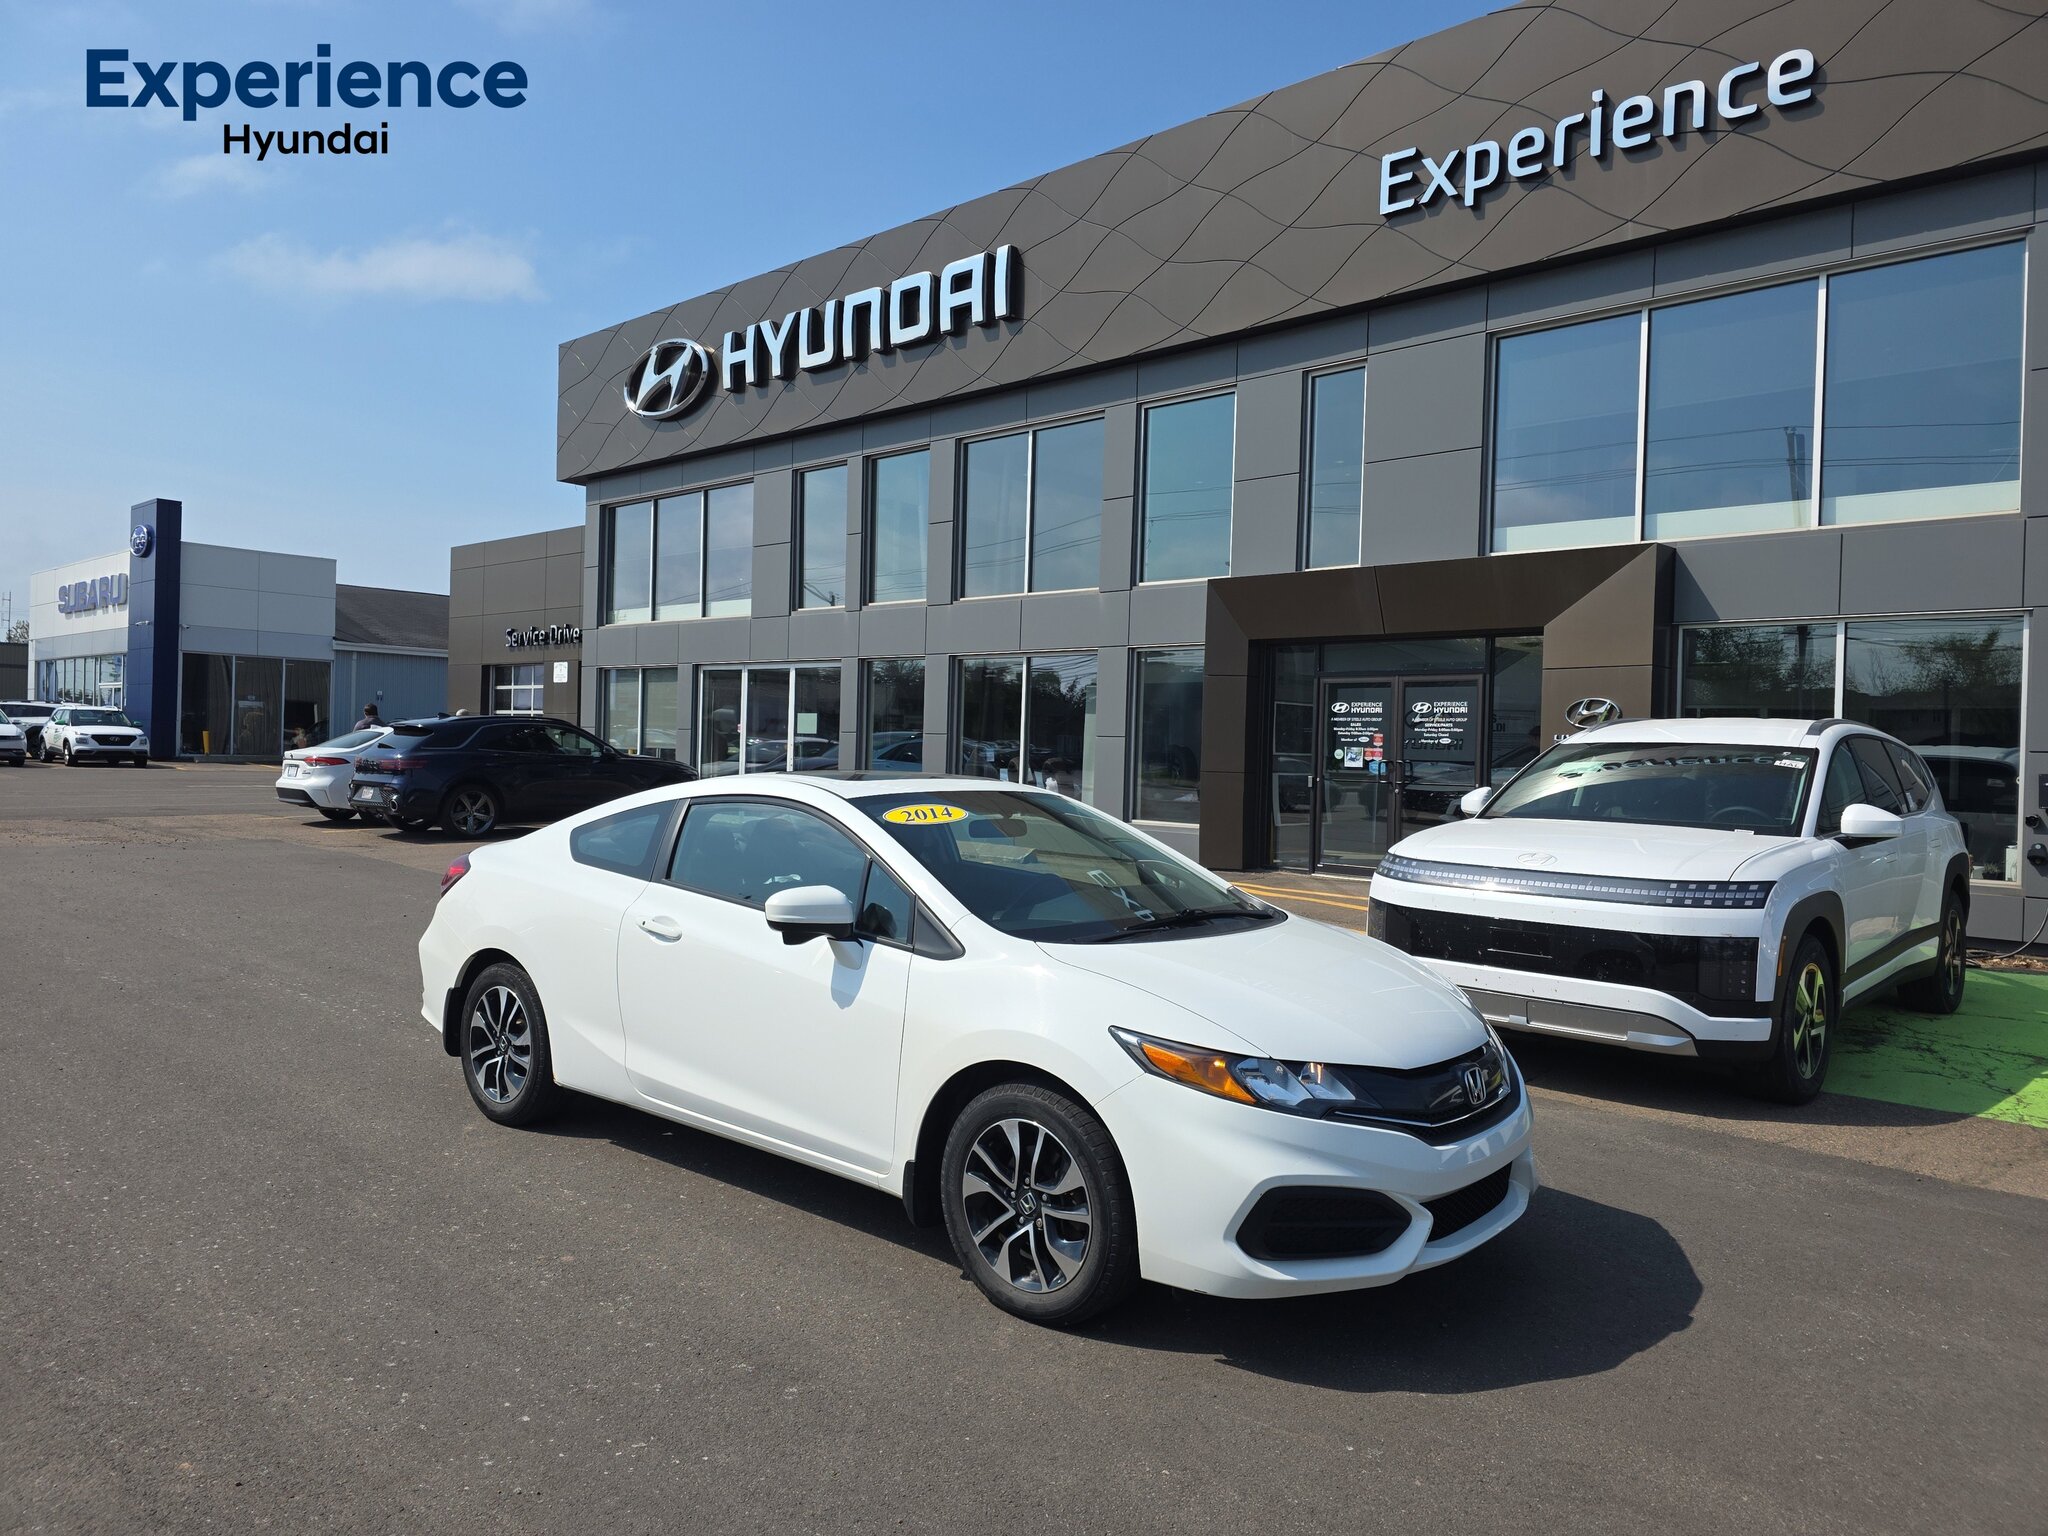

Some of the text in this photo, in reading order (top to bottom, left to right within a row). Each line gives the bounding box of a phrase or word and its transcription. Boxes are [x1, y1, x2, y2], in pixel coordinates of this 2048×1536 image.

[1380, 48, 1815, 216] Experience
[722, 244, 1016, 392] HYUNDAI
[58, 573, 128, 614] SUBARU
[505, 624, 580, 647] Service Drive
[900, 806, 953, 823] 2014
